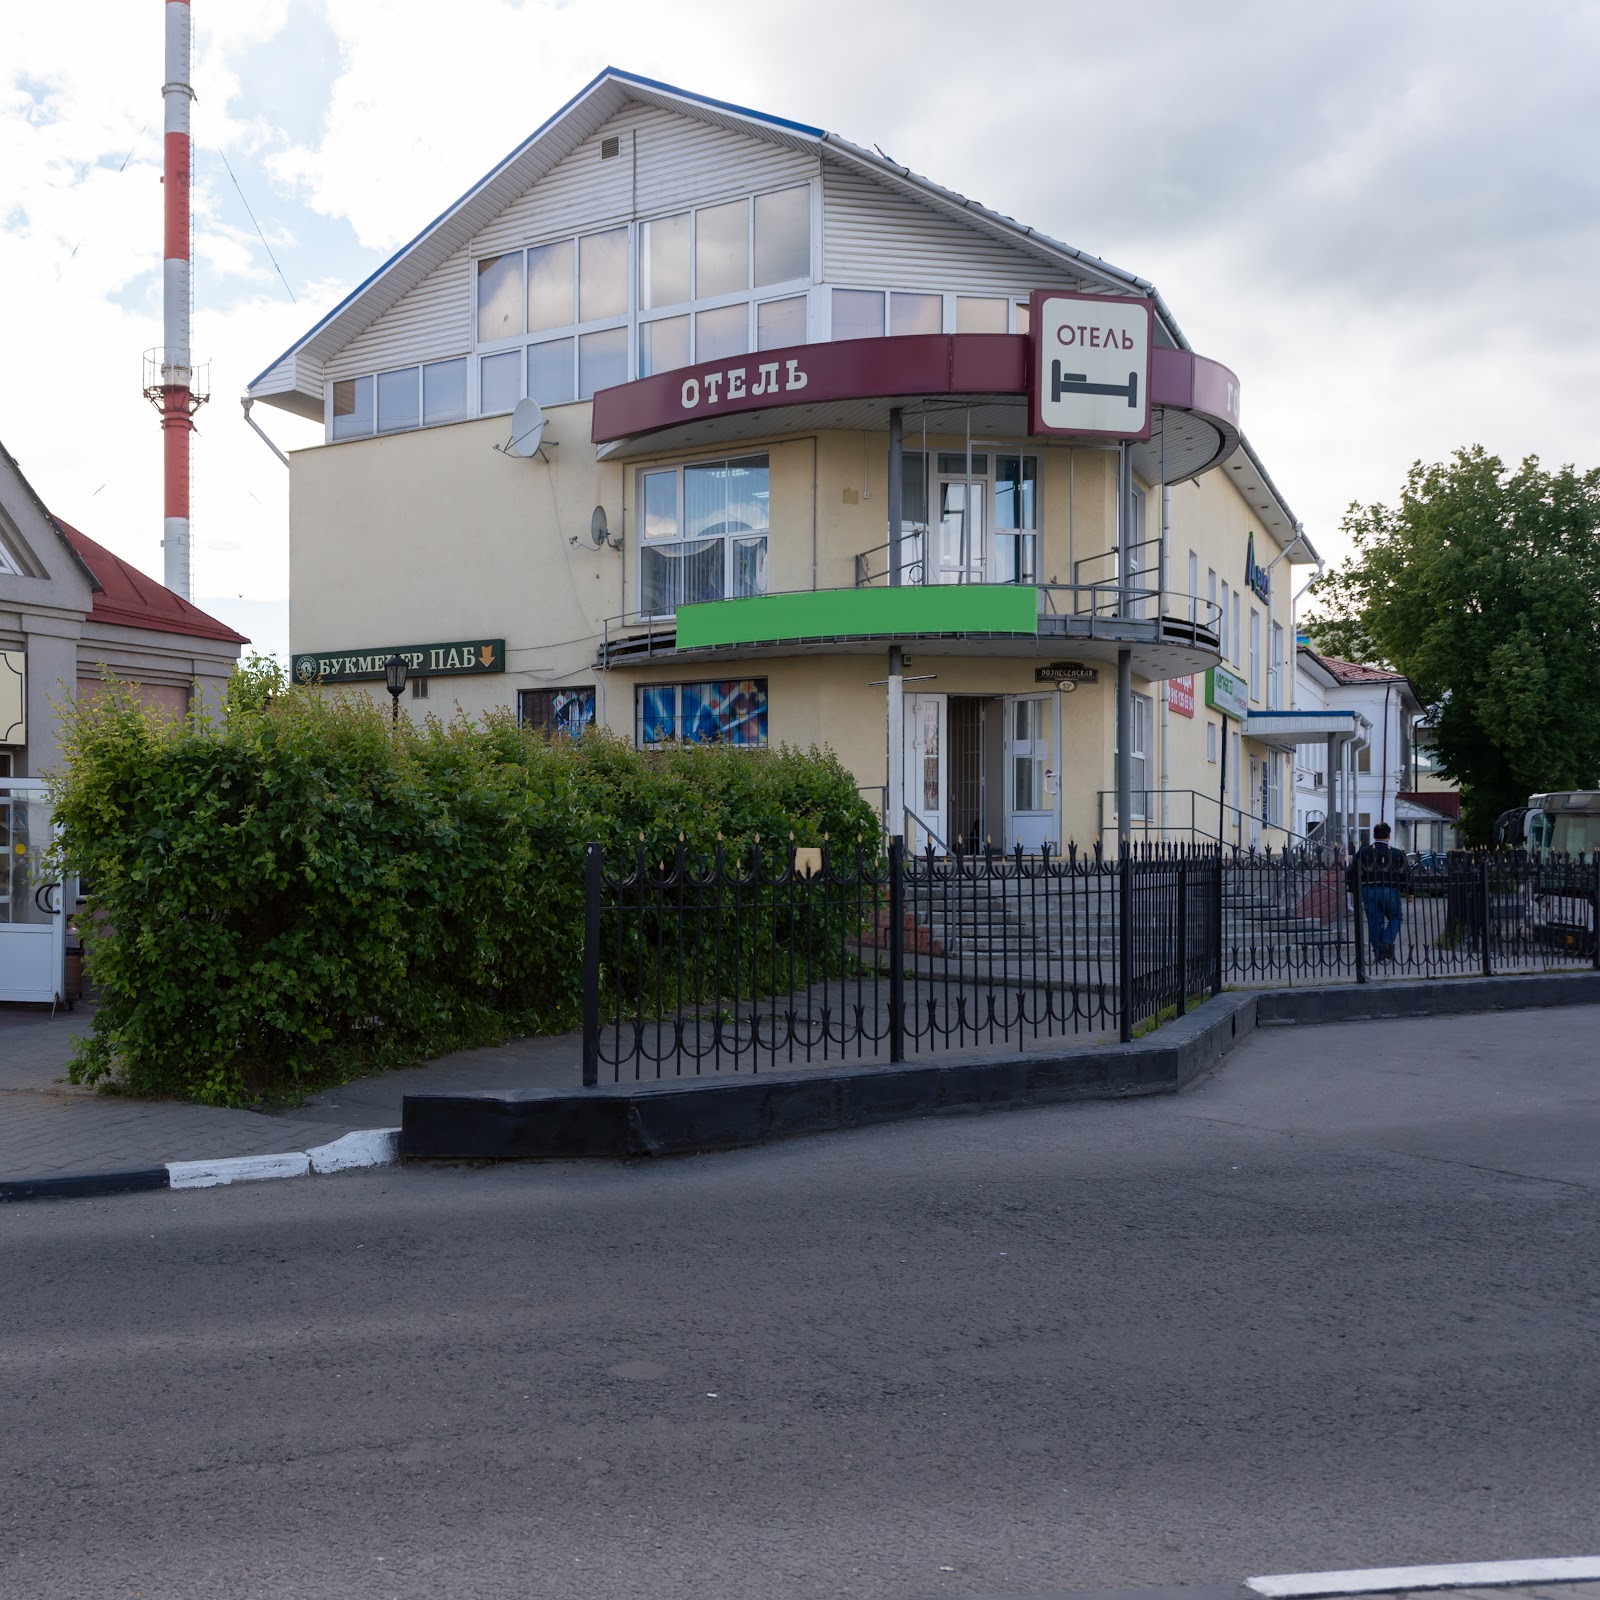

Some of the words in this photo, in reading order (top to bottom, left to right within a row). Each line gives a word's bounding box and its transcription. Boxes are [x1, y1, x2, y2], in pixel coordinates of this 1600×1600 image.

[1057, 325, 1134, 350] ОТЕЛЬ
[682, 359, 808, 409] ОТЕЛЬ
[319, 652, 424, 676] БУКМЕЕР
[429, 647, 476, 670] ПАБ
